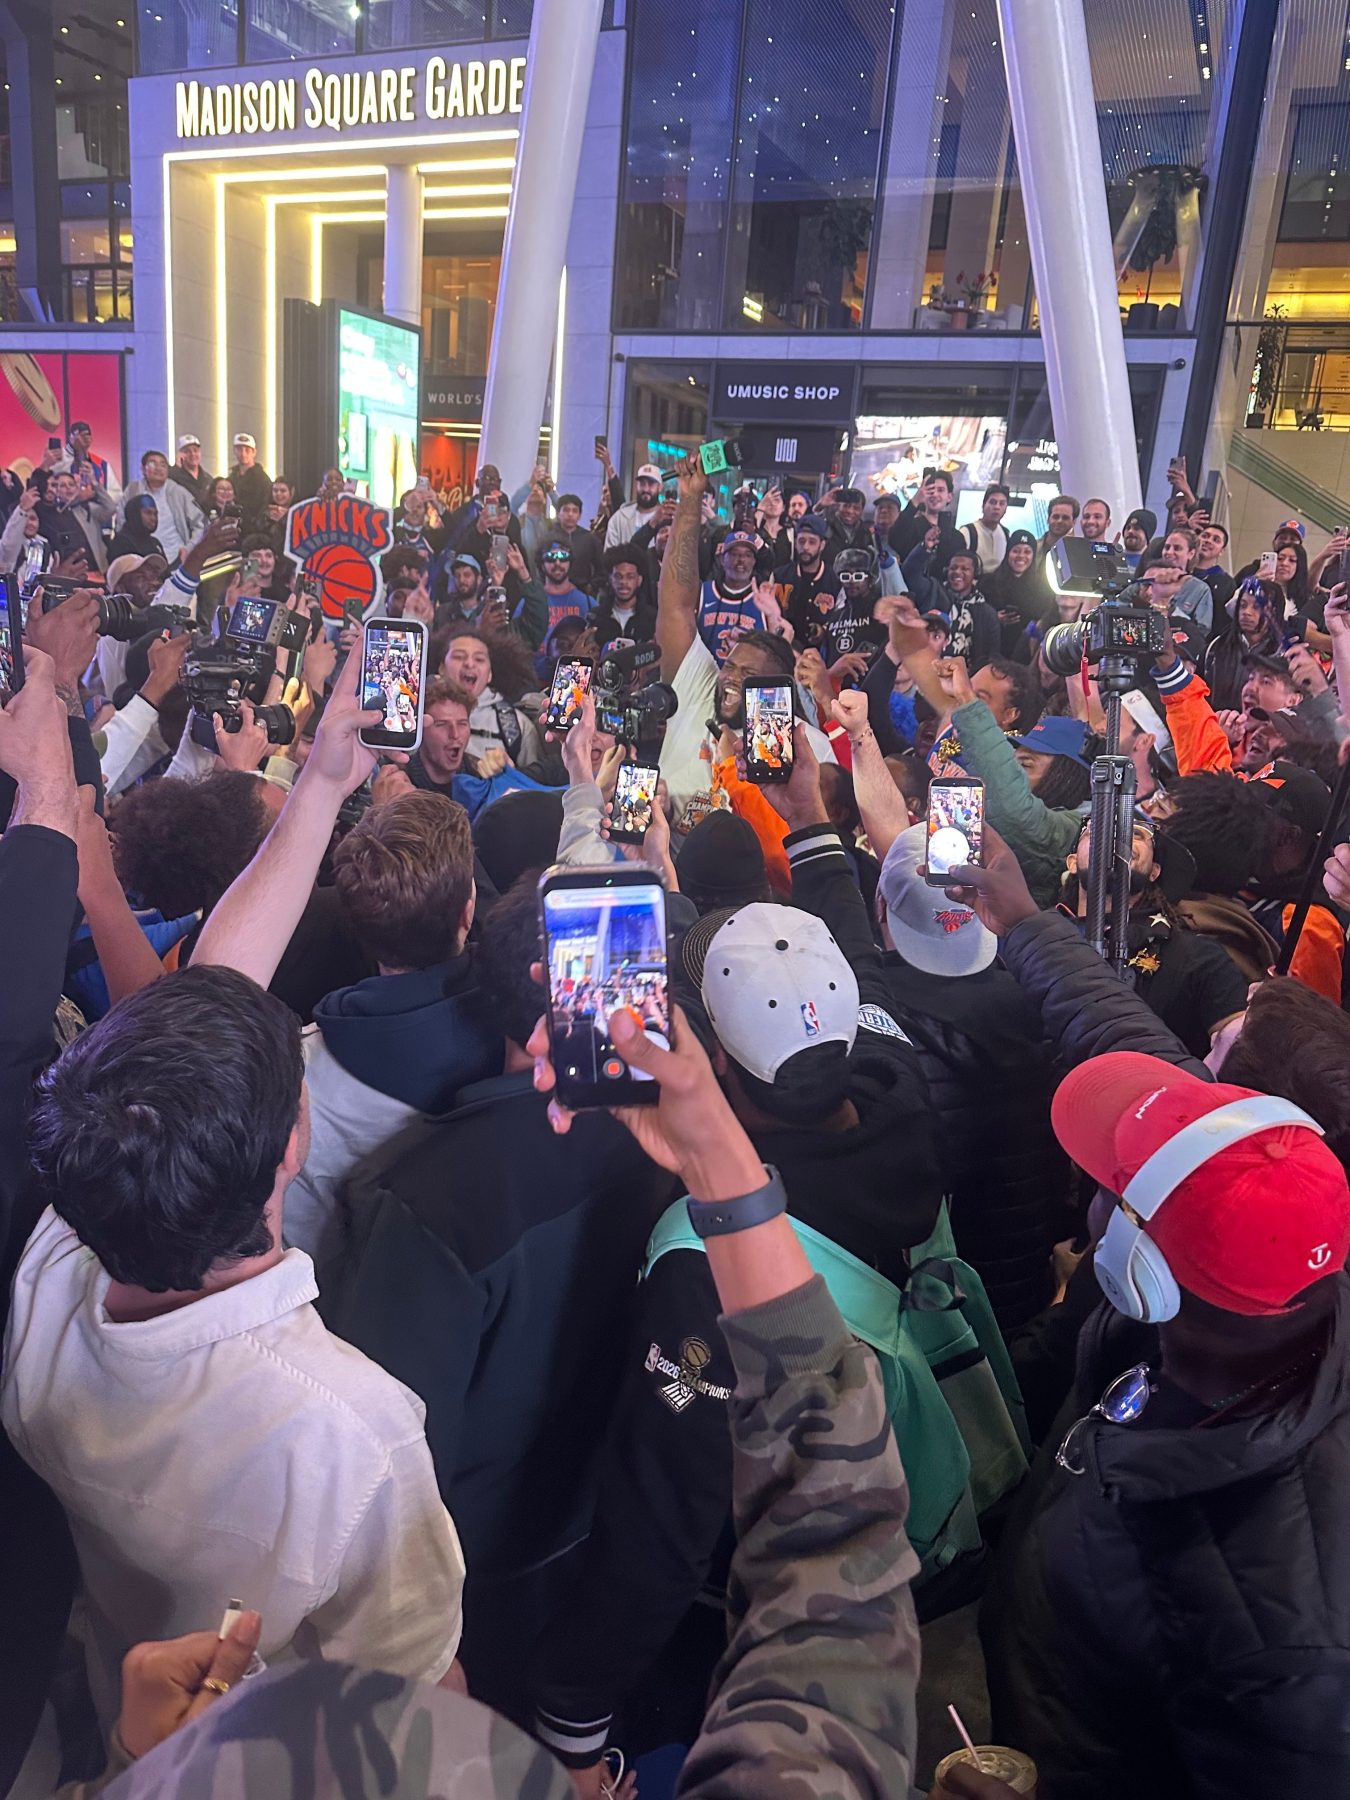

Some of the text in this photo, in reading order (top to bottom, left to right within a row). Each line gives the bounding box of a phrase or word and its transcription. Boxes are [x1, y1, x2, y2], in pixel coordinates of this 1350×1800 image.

[175, 56, 527, 138] MADISON SQUARE GARDE
[428, 392, 482, 405] WORLD'S
[727, 384, 840, 400] UMUSIC SHOP
[292, 498, 386, 549] KNICKS
[656, 1357, 681, 1379] 2026
